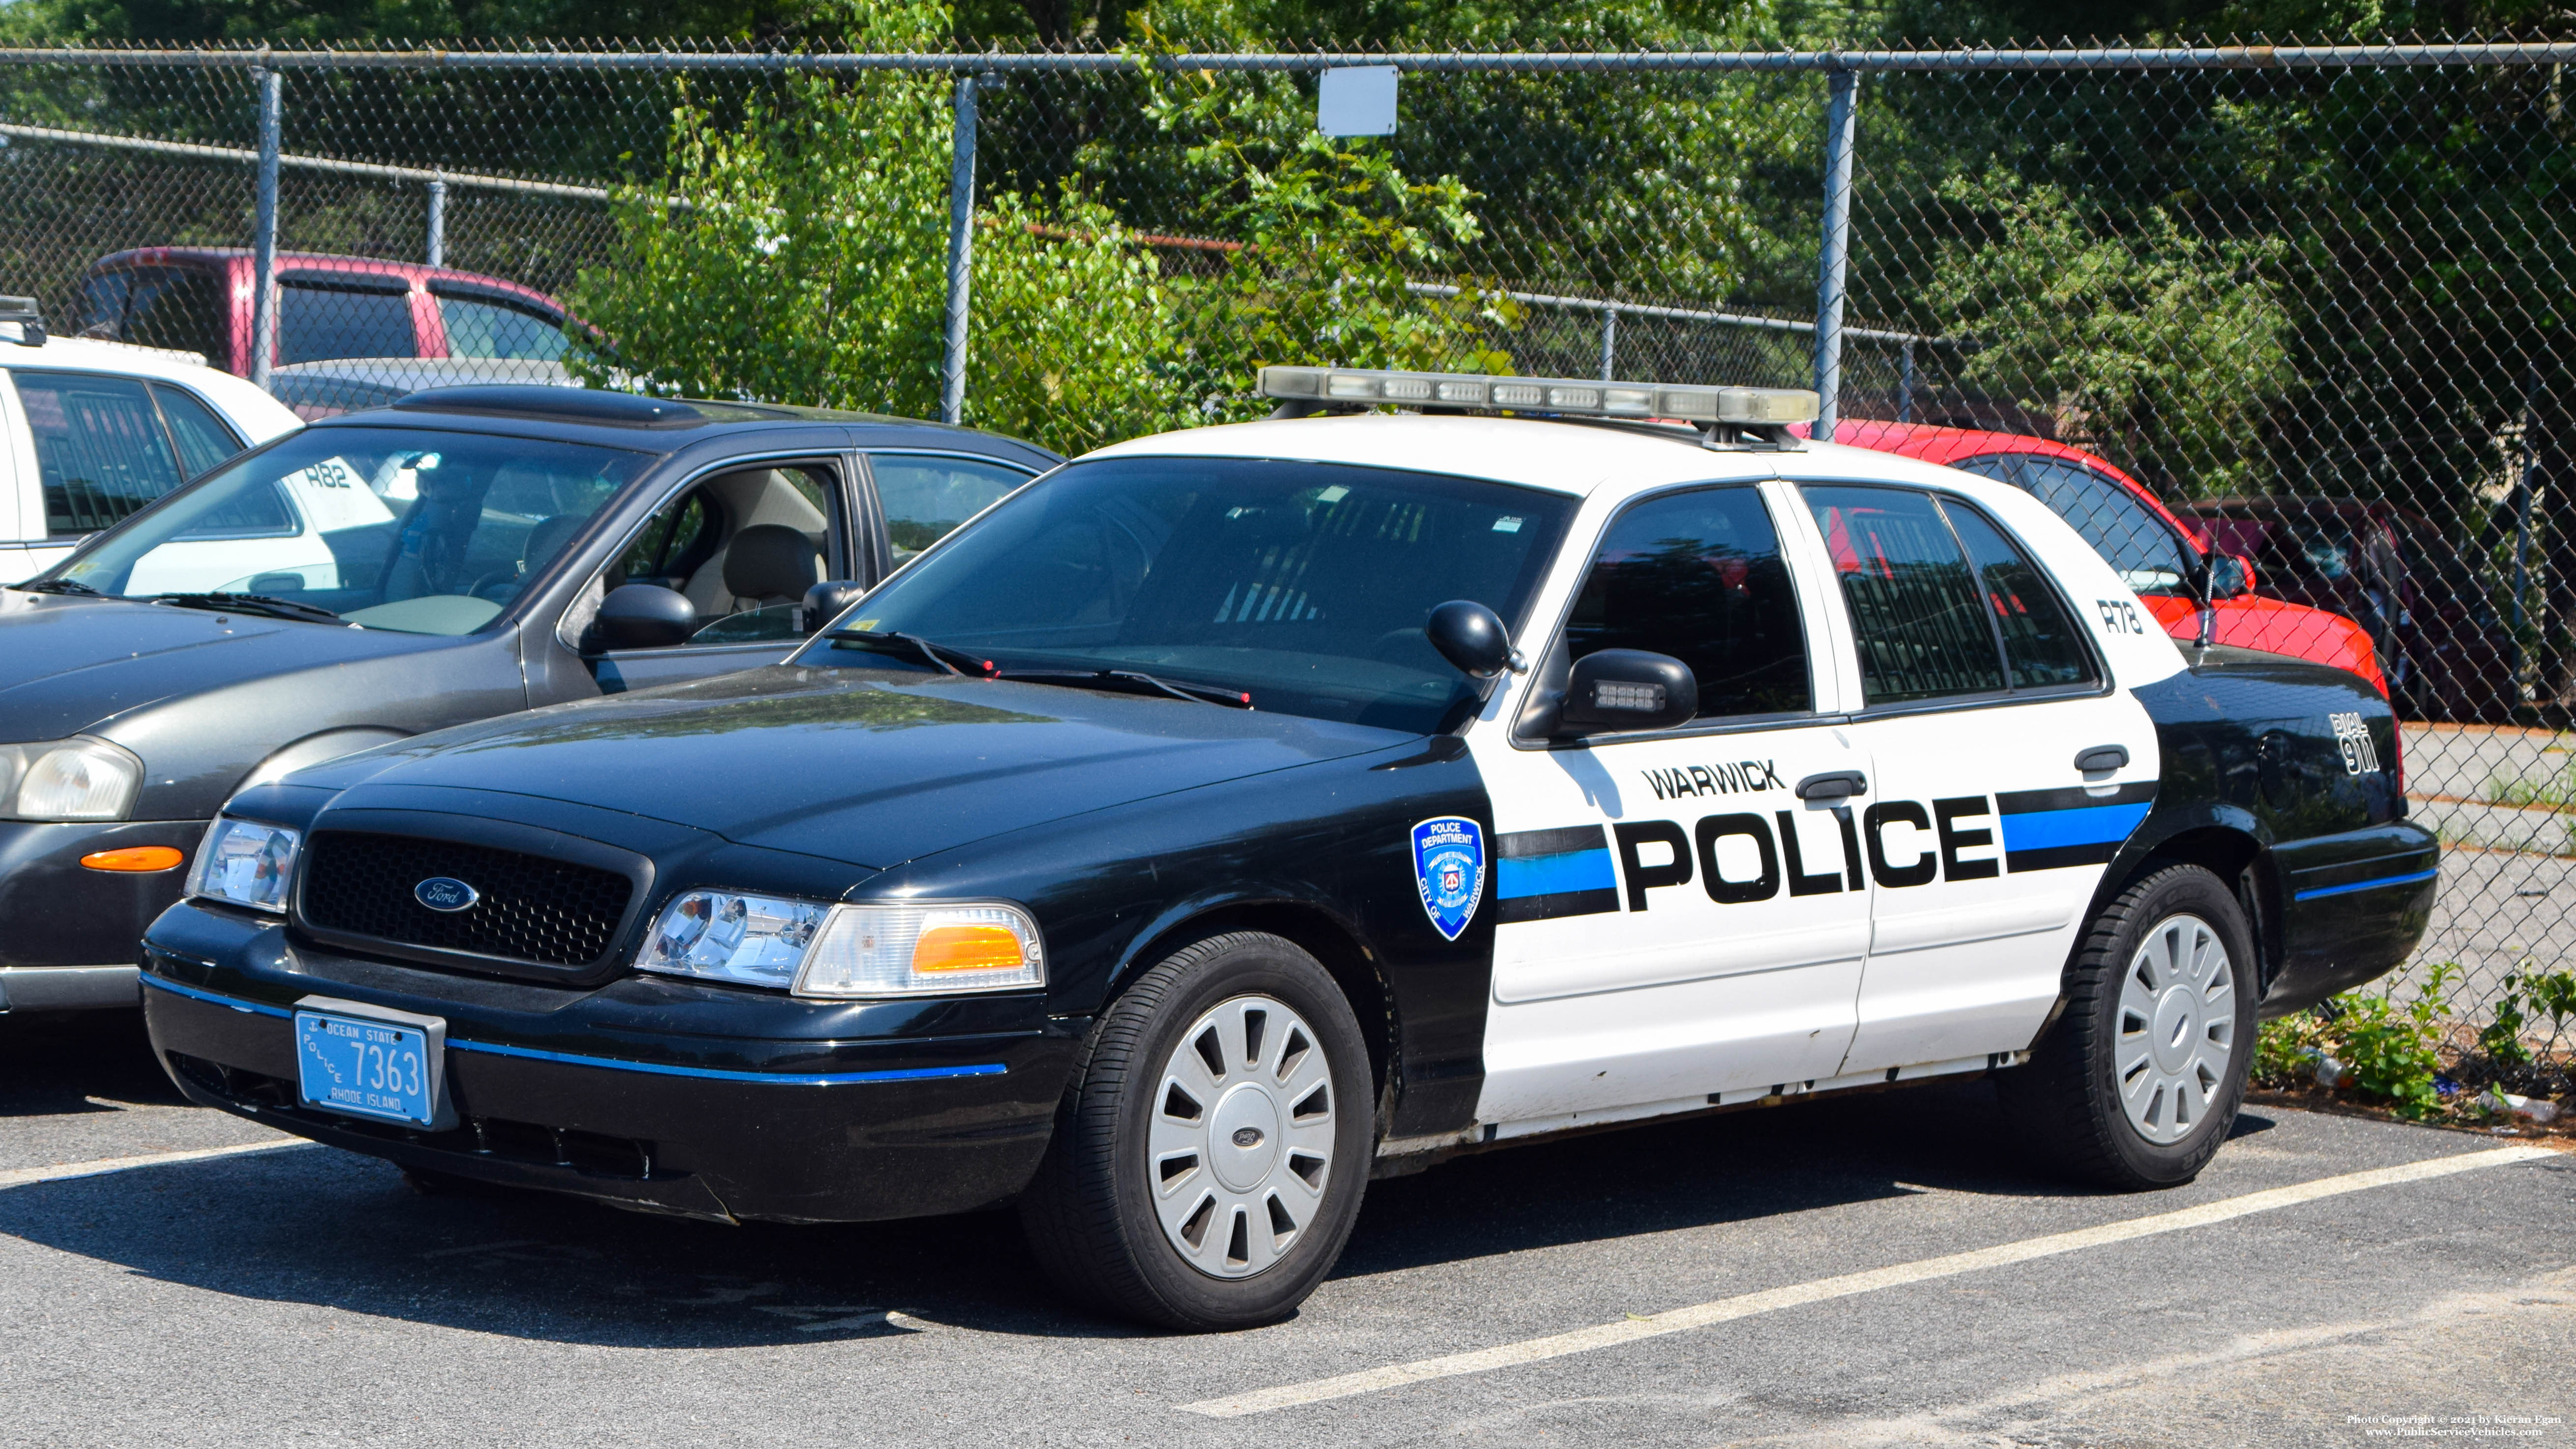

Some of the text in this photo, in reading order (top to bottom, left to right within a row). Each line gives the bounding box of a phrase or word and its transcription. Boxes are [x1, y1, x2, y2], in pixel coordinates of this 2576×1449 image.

[304, 463, 351, 488] R82
[2096, 599, 2143, 634] R78
[2329, 712, 2368, 736] DIAL
[2339, 734, 2380, 775] 911
[1641, 759, 1786, 800] WARWICK
[1431, 822, 1461, 834] POLICE
[1422, 833, 1473, 849] DEPARTMENT
[1613, 795, 1999, 913] POLICE
[427, 883, 460, 903] Ford
[1420, 877, 1433, 903] CITY
[1430, 905, 1441, 919] OF
[1463, 865, 1483, 918] WARWICK
[326, 1023, 396, 1046] OCEAN STATE
[304, 1034, 342, 1083] POLICE
[351, 1041, 418, 1096] 7363
[331, 1087, 400, 1111] RHODE ISLAND
[1238, 1132, 1256, 1143] Ford
